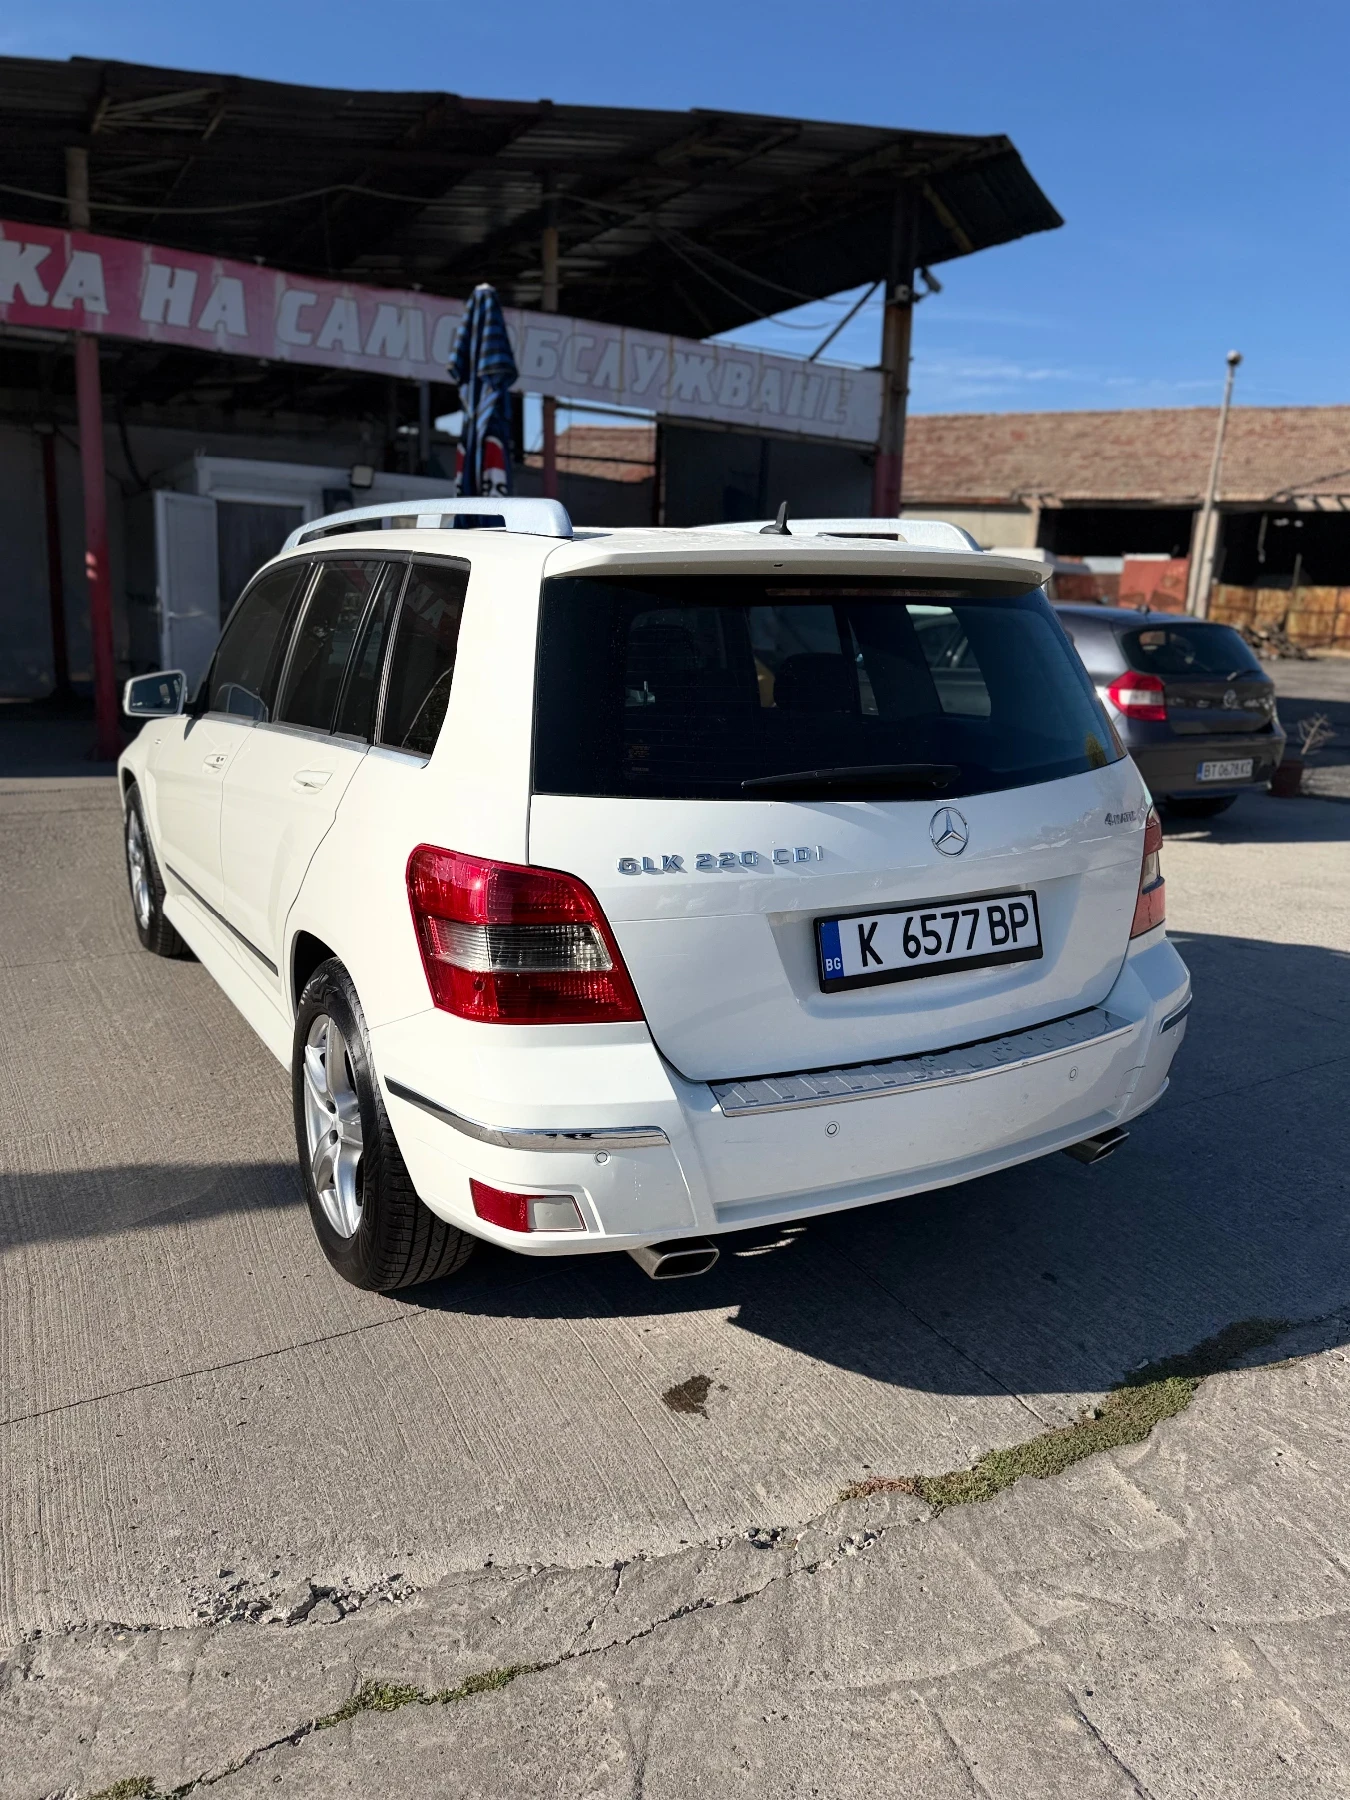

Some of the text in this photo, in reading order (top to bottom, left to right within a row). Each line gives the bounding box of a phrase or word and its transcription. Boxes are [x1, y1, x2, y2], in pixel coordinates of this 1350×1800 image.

[139, 263, 249, 336] НА
[277, 289, 853, 424] САМОБСЛУЖВАНЕ
[617, 845, 825, 875] GLK 220 CDI
[857, 902, 1029, 968] K 6577 BP
[825, 956, 842, 972] BG
